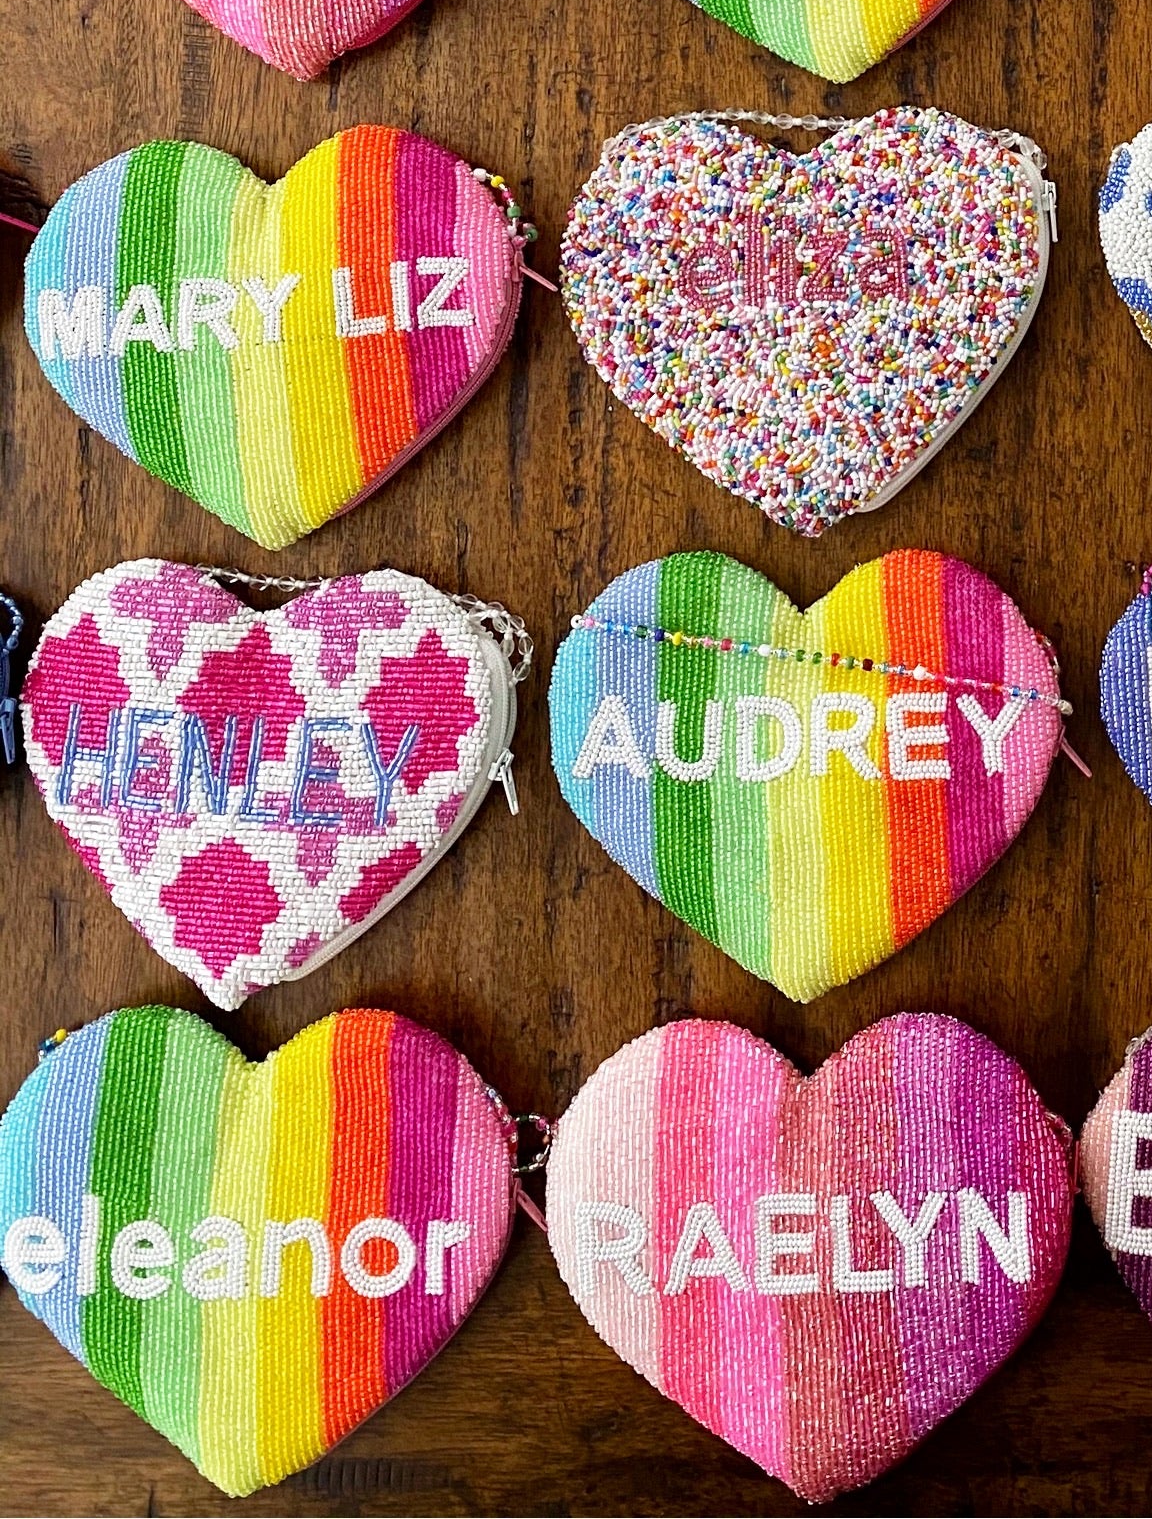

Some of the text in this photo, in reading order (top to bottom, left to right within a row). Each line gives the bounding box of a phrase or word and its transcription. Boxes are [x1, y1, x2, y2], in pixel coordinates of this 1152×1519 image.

[36, 256, 475, 361] MARY LIZ
[678, 207, 907, 311] eliza
[55, 704, 420, 826] HENLEY
[572, 691, 1028, 783] AUDREY
[2, 1194, 471, 1301] eleanor
[574, 1187, 1032, 1297] RAELYN
